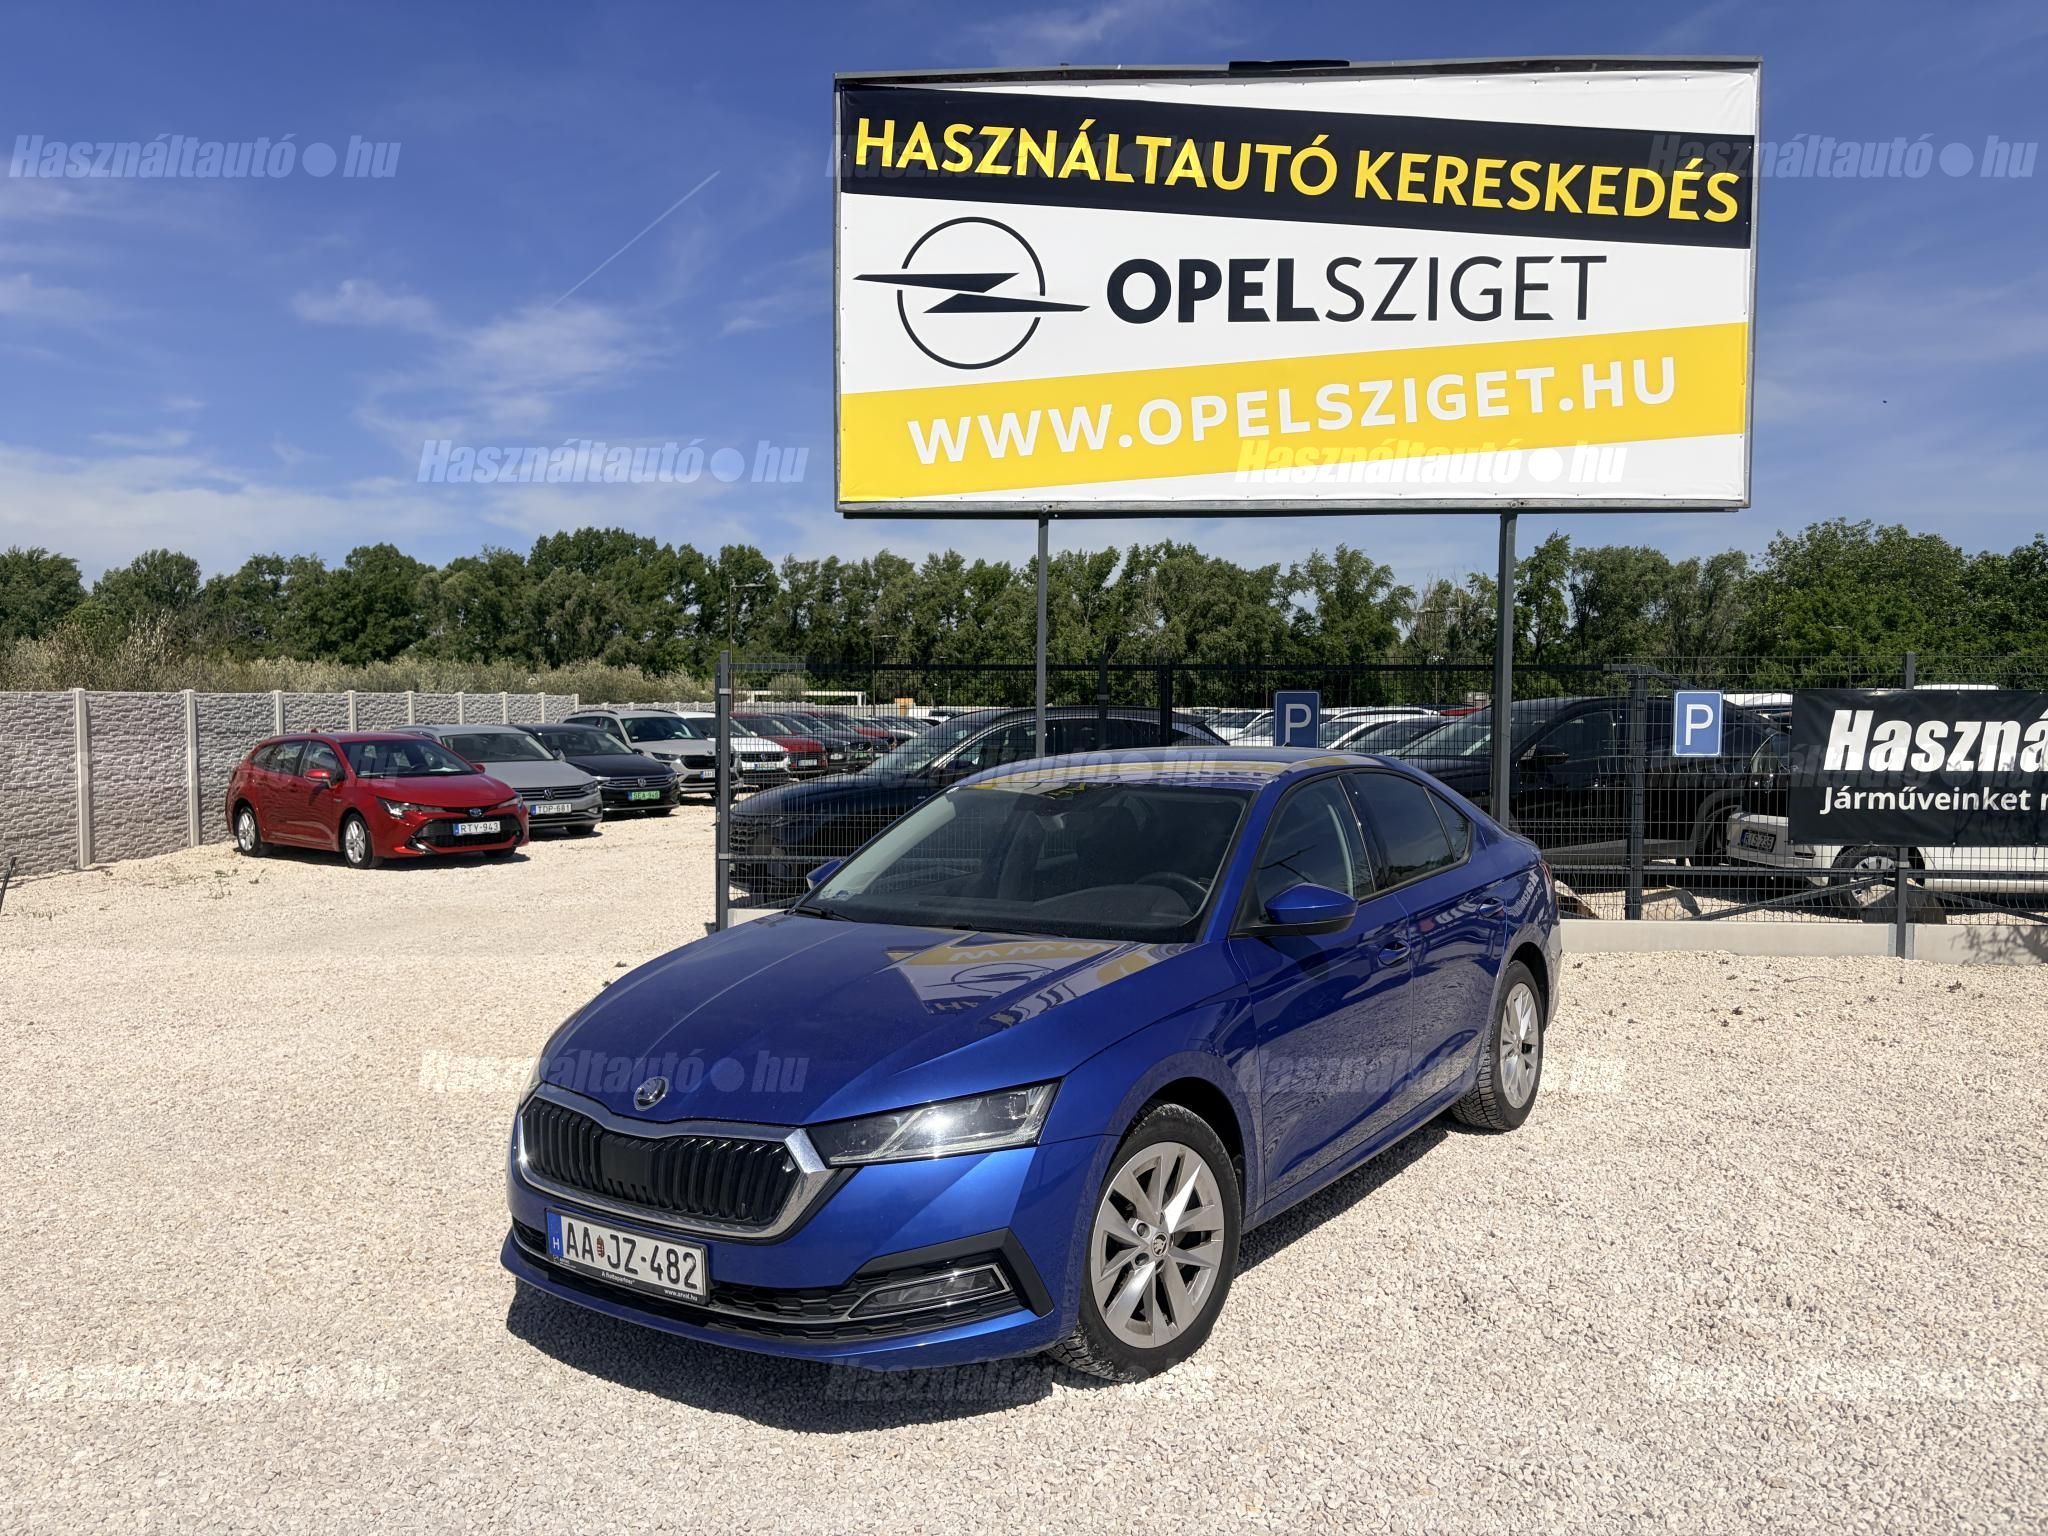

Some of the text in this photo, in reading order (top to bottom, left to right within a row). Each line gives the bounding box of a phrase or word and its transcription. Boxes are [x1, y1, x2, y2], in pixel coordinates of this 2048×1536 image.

[855, 118, 1739, 223] HASZNÁLTAUTÓ KERESKEDÉS
[1106, 255, 1607, 324] OPELSZIGET
[907, 357, 1675, 465] WWW.OPELSZIGET.HU
[1282, 703, 1312, 748] P
[1685, 703, 1714, 746] P
[1819, 785, 2032, 815] Járműveinket
[460, 822, 499, 834] RTY-943
